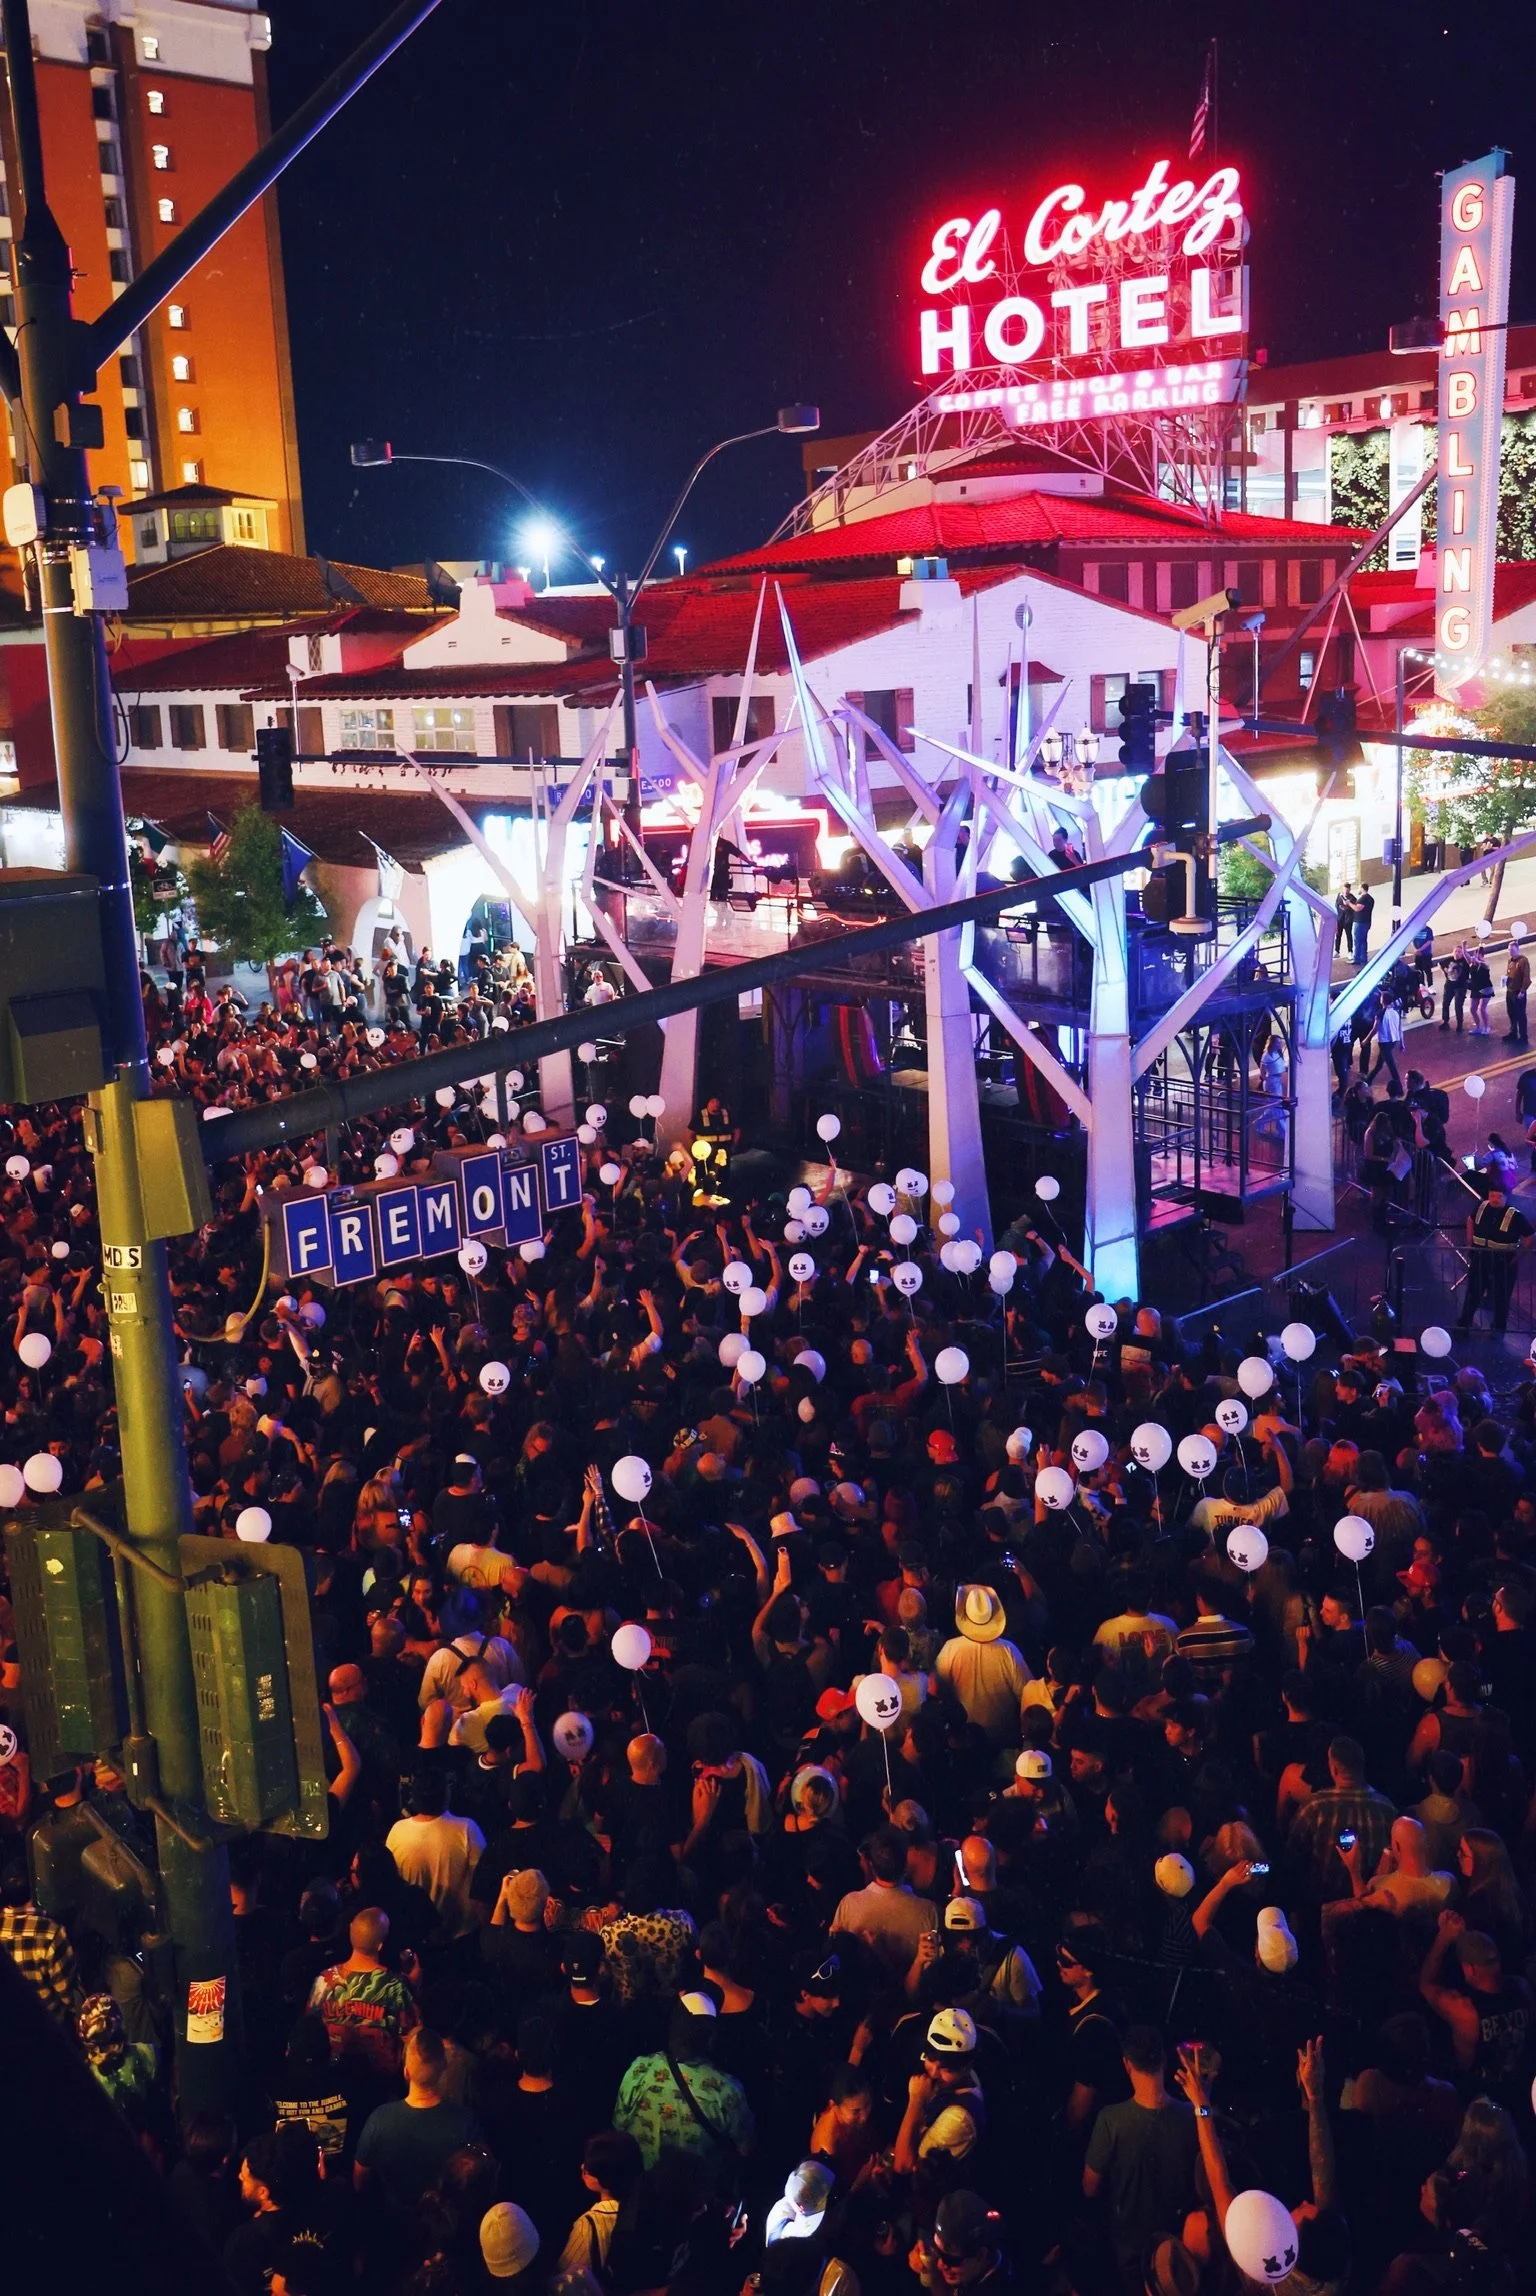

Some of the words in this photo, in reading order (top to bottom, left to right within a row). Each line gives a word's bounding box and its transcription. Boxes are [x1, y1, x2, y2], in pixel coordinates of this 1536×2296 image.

[920, 208, 1001, 295] El
[1023, 159, 1244, 266] Cortez
[920, 267, 1242, 374] HOTEL
[1016, 399, 1083, 424] FREE
[1094, 382, 1221, 416] PARKING
[1052, 374, 1124, 399] SHOP
[1166, 361, 1224, 385] BAR
[1440, 182, 1484, 651] GAMBLING
[550, 1143, 571, 1161] ST.
[298, 1163, 572, 1269] FREMONT
